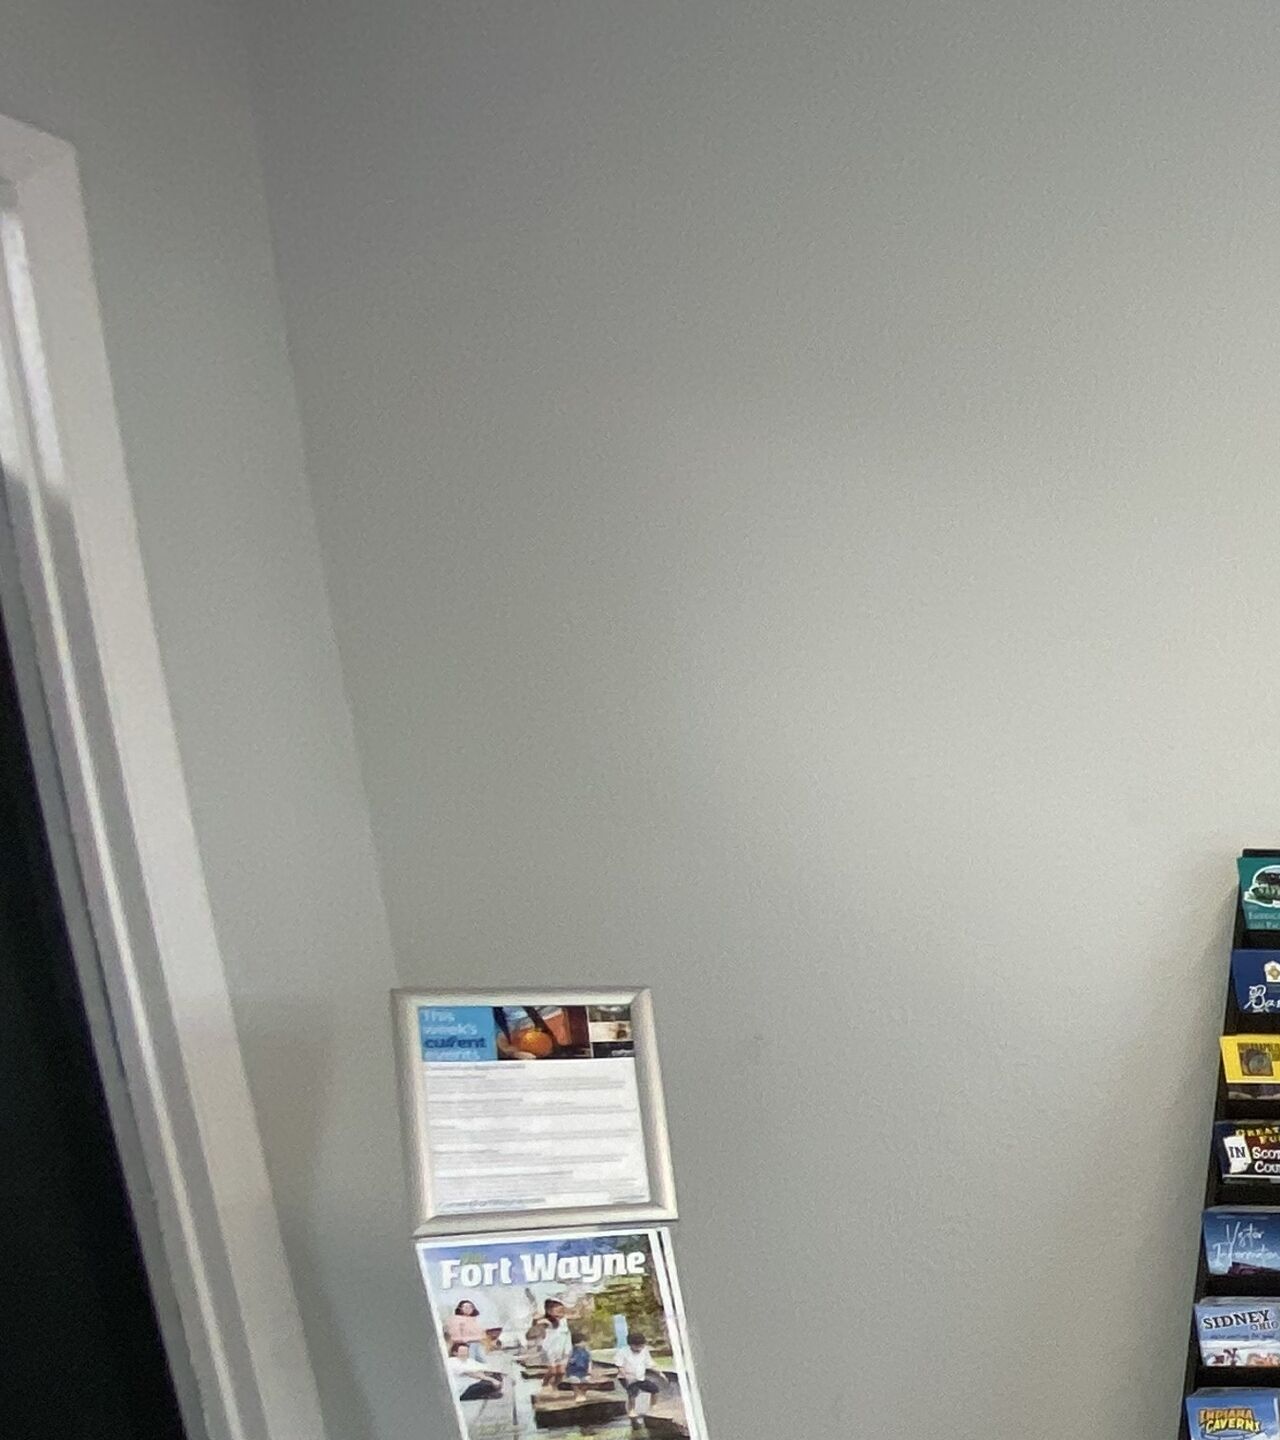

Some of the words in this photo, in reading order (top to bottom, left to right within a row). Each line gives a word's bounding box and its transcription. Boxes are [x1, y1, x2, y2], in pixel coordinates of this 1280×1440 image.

[424, 1036, 487, 1048] current
[1229, 1146, 1245, 1158] IN
[439, 1257, 512, 1290] Fort
[519, 1251, 646, 1283] Wayne
[1203, 1310, 1270, 1330] SIDNEY
[1250, 1320, 1279, 1331] OHIO
[1200, 1408, 1253, 1421] INDIANA
[1205, 1418, 1261, 1433] CAVERNS
